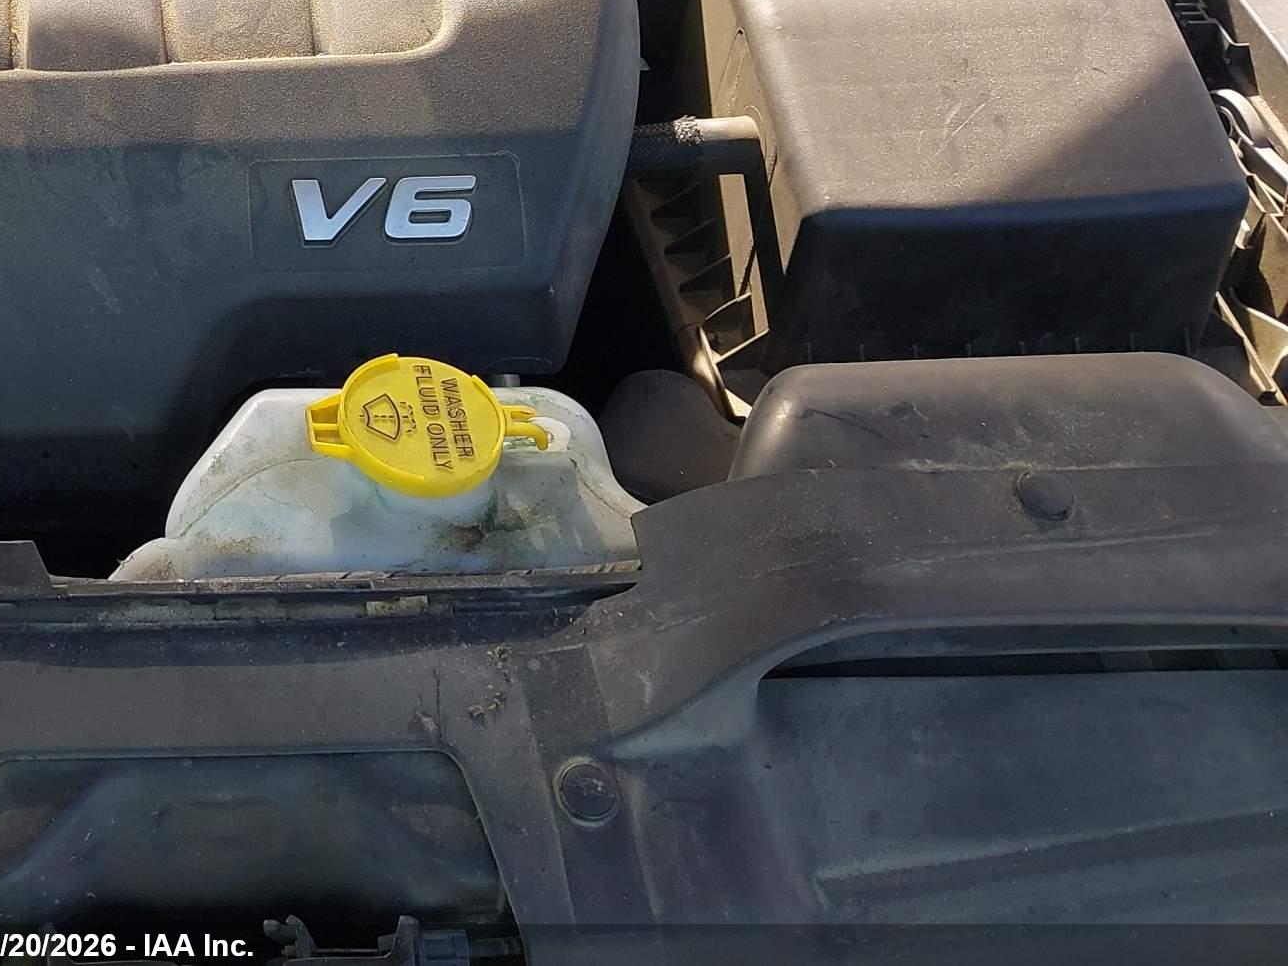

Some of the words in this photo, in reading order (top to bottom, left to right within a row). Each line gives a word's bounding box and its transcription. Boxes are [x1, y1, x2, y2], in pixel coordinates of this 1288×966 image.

[291, 174, 477, 241] V6
[412, 363, 441, 418] FLUID
[440, 377, 476, 461] WASHER
[425, 422, 455, 472] ONLY
